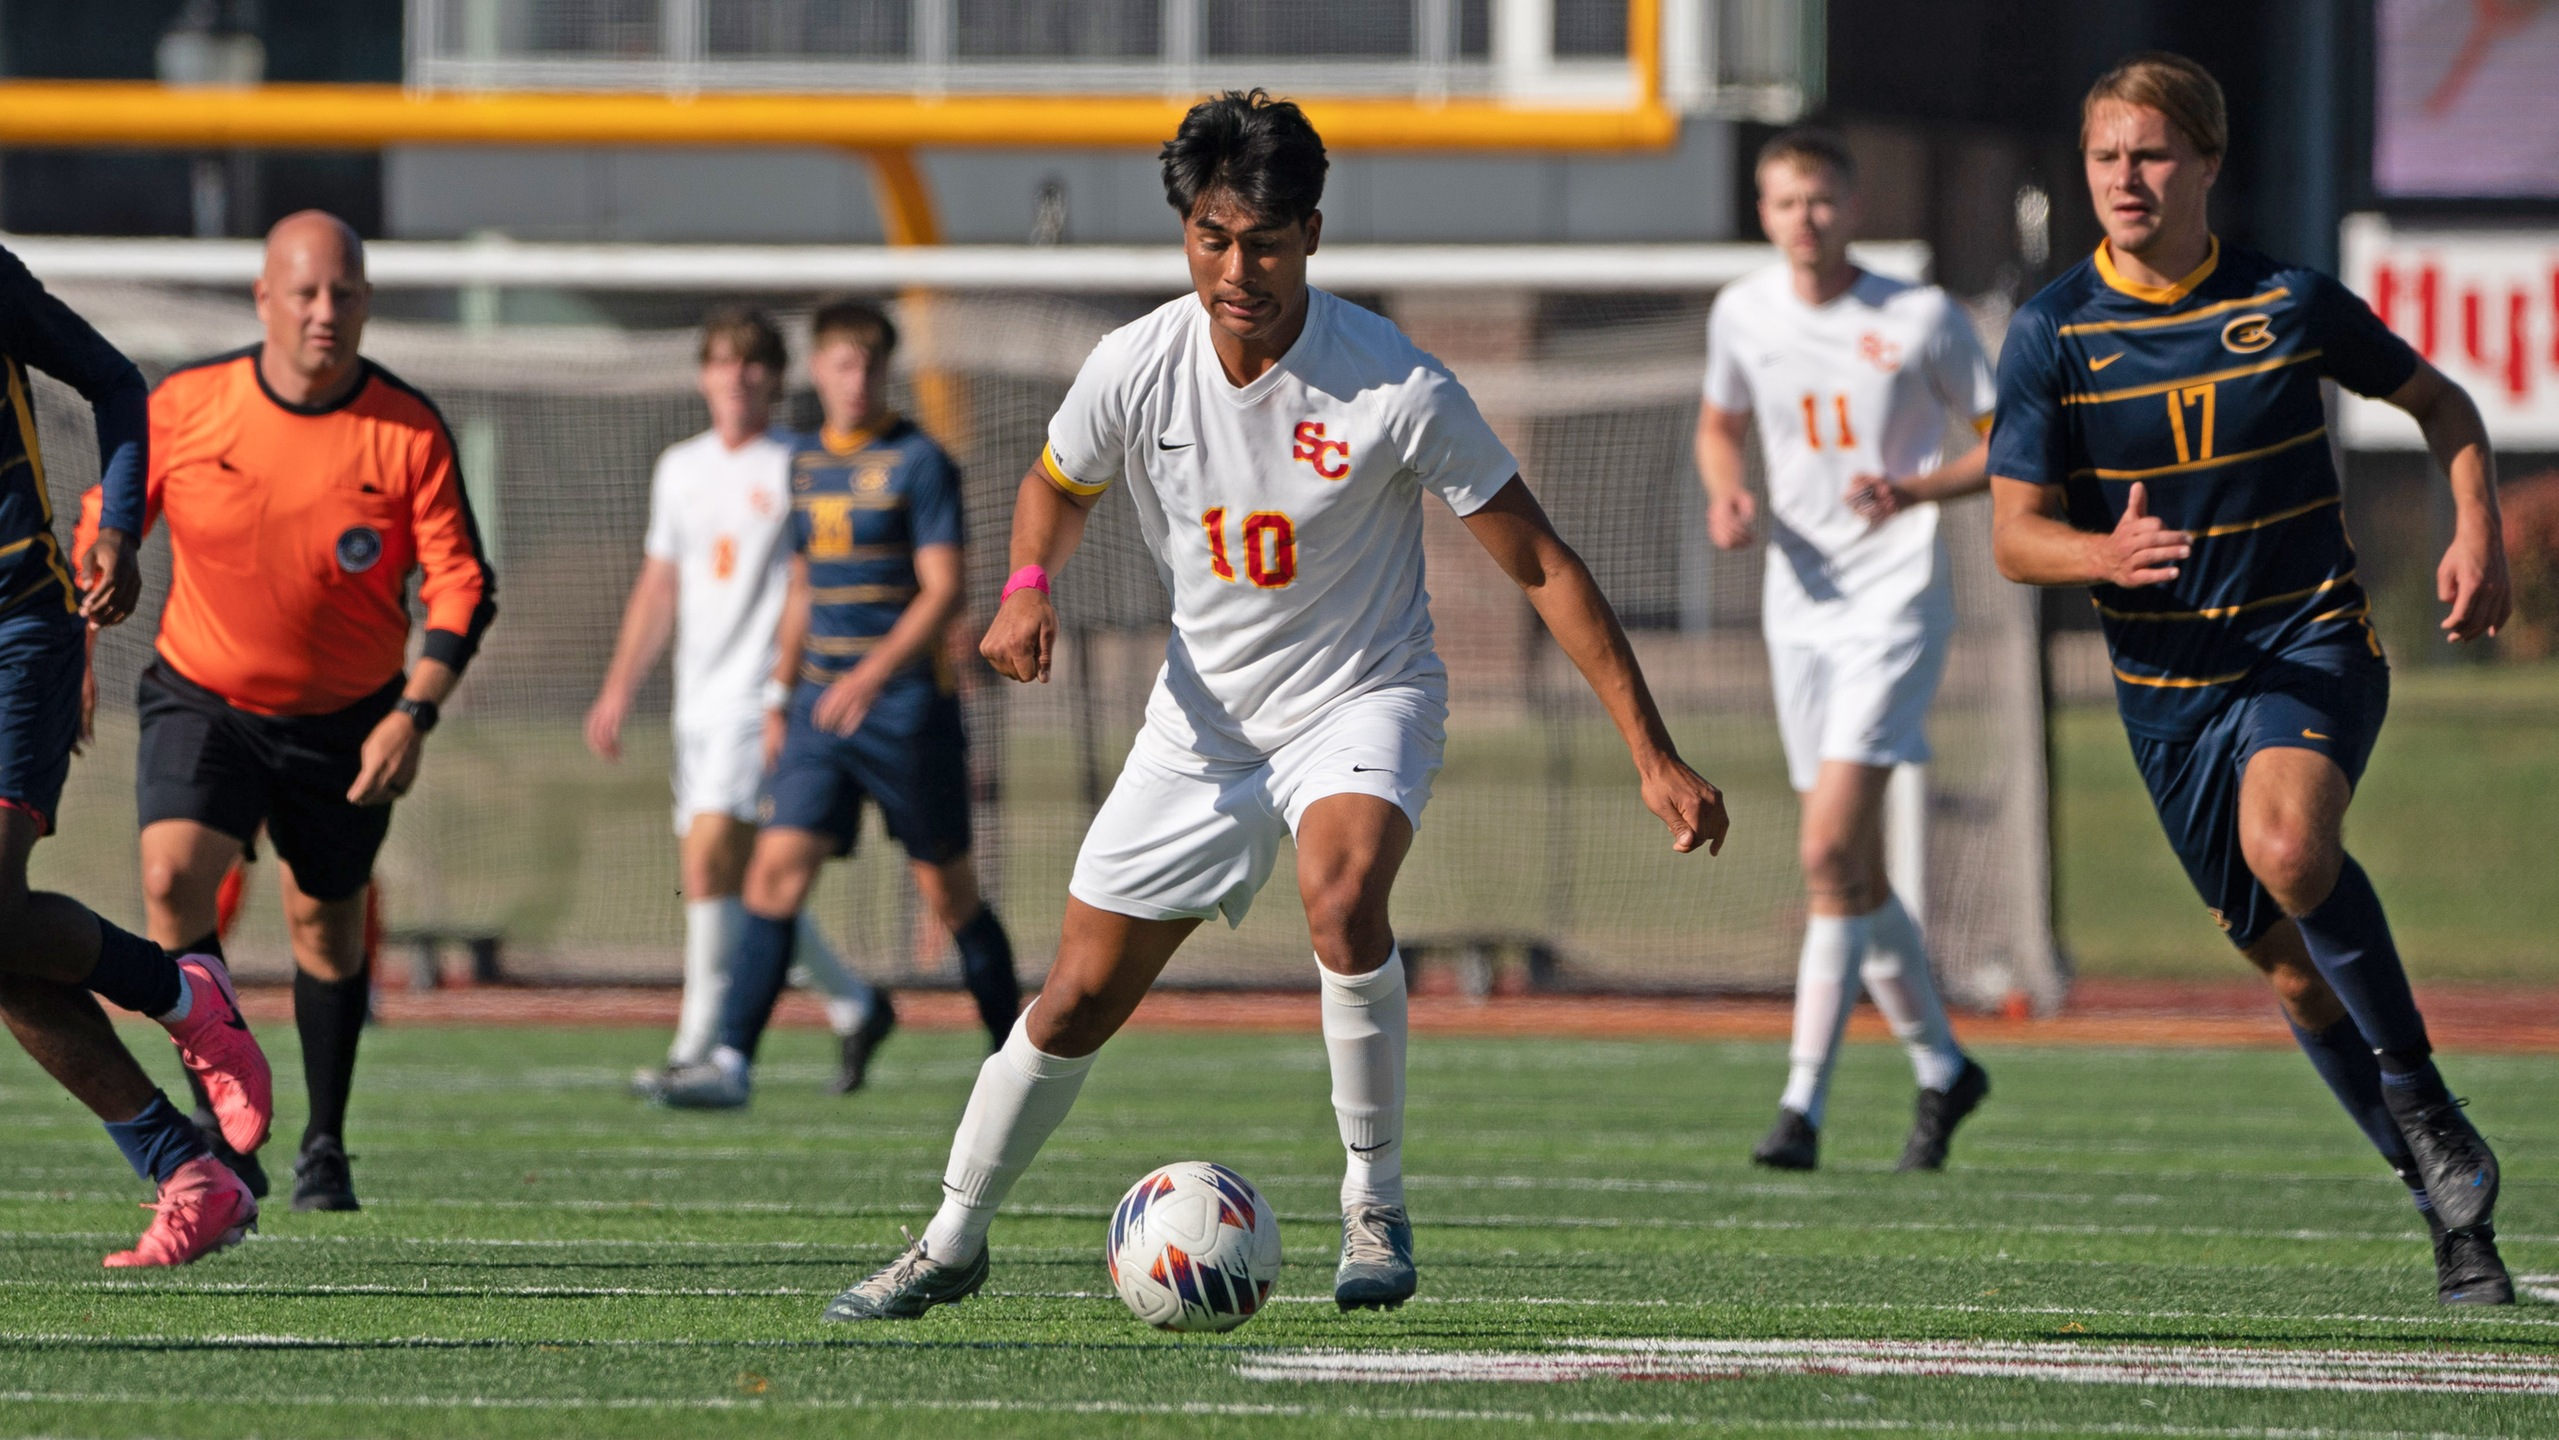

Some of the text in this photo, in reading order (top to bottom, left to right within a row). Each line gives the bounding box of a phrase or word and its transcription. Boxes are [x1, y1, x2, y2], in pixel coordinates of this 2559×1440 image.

[2374, 265, 2559, 400] Hy
[1293, 421, 1351, 480] SC
[1803, 393, 1857, 449] 11
[2167, 382, 2216, 464] 17
[1202, 506, 1298, 589] 10
